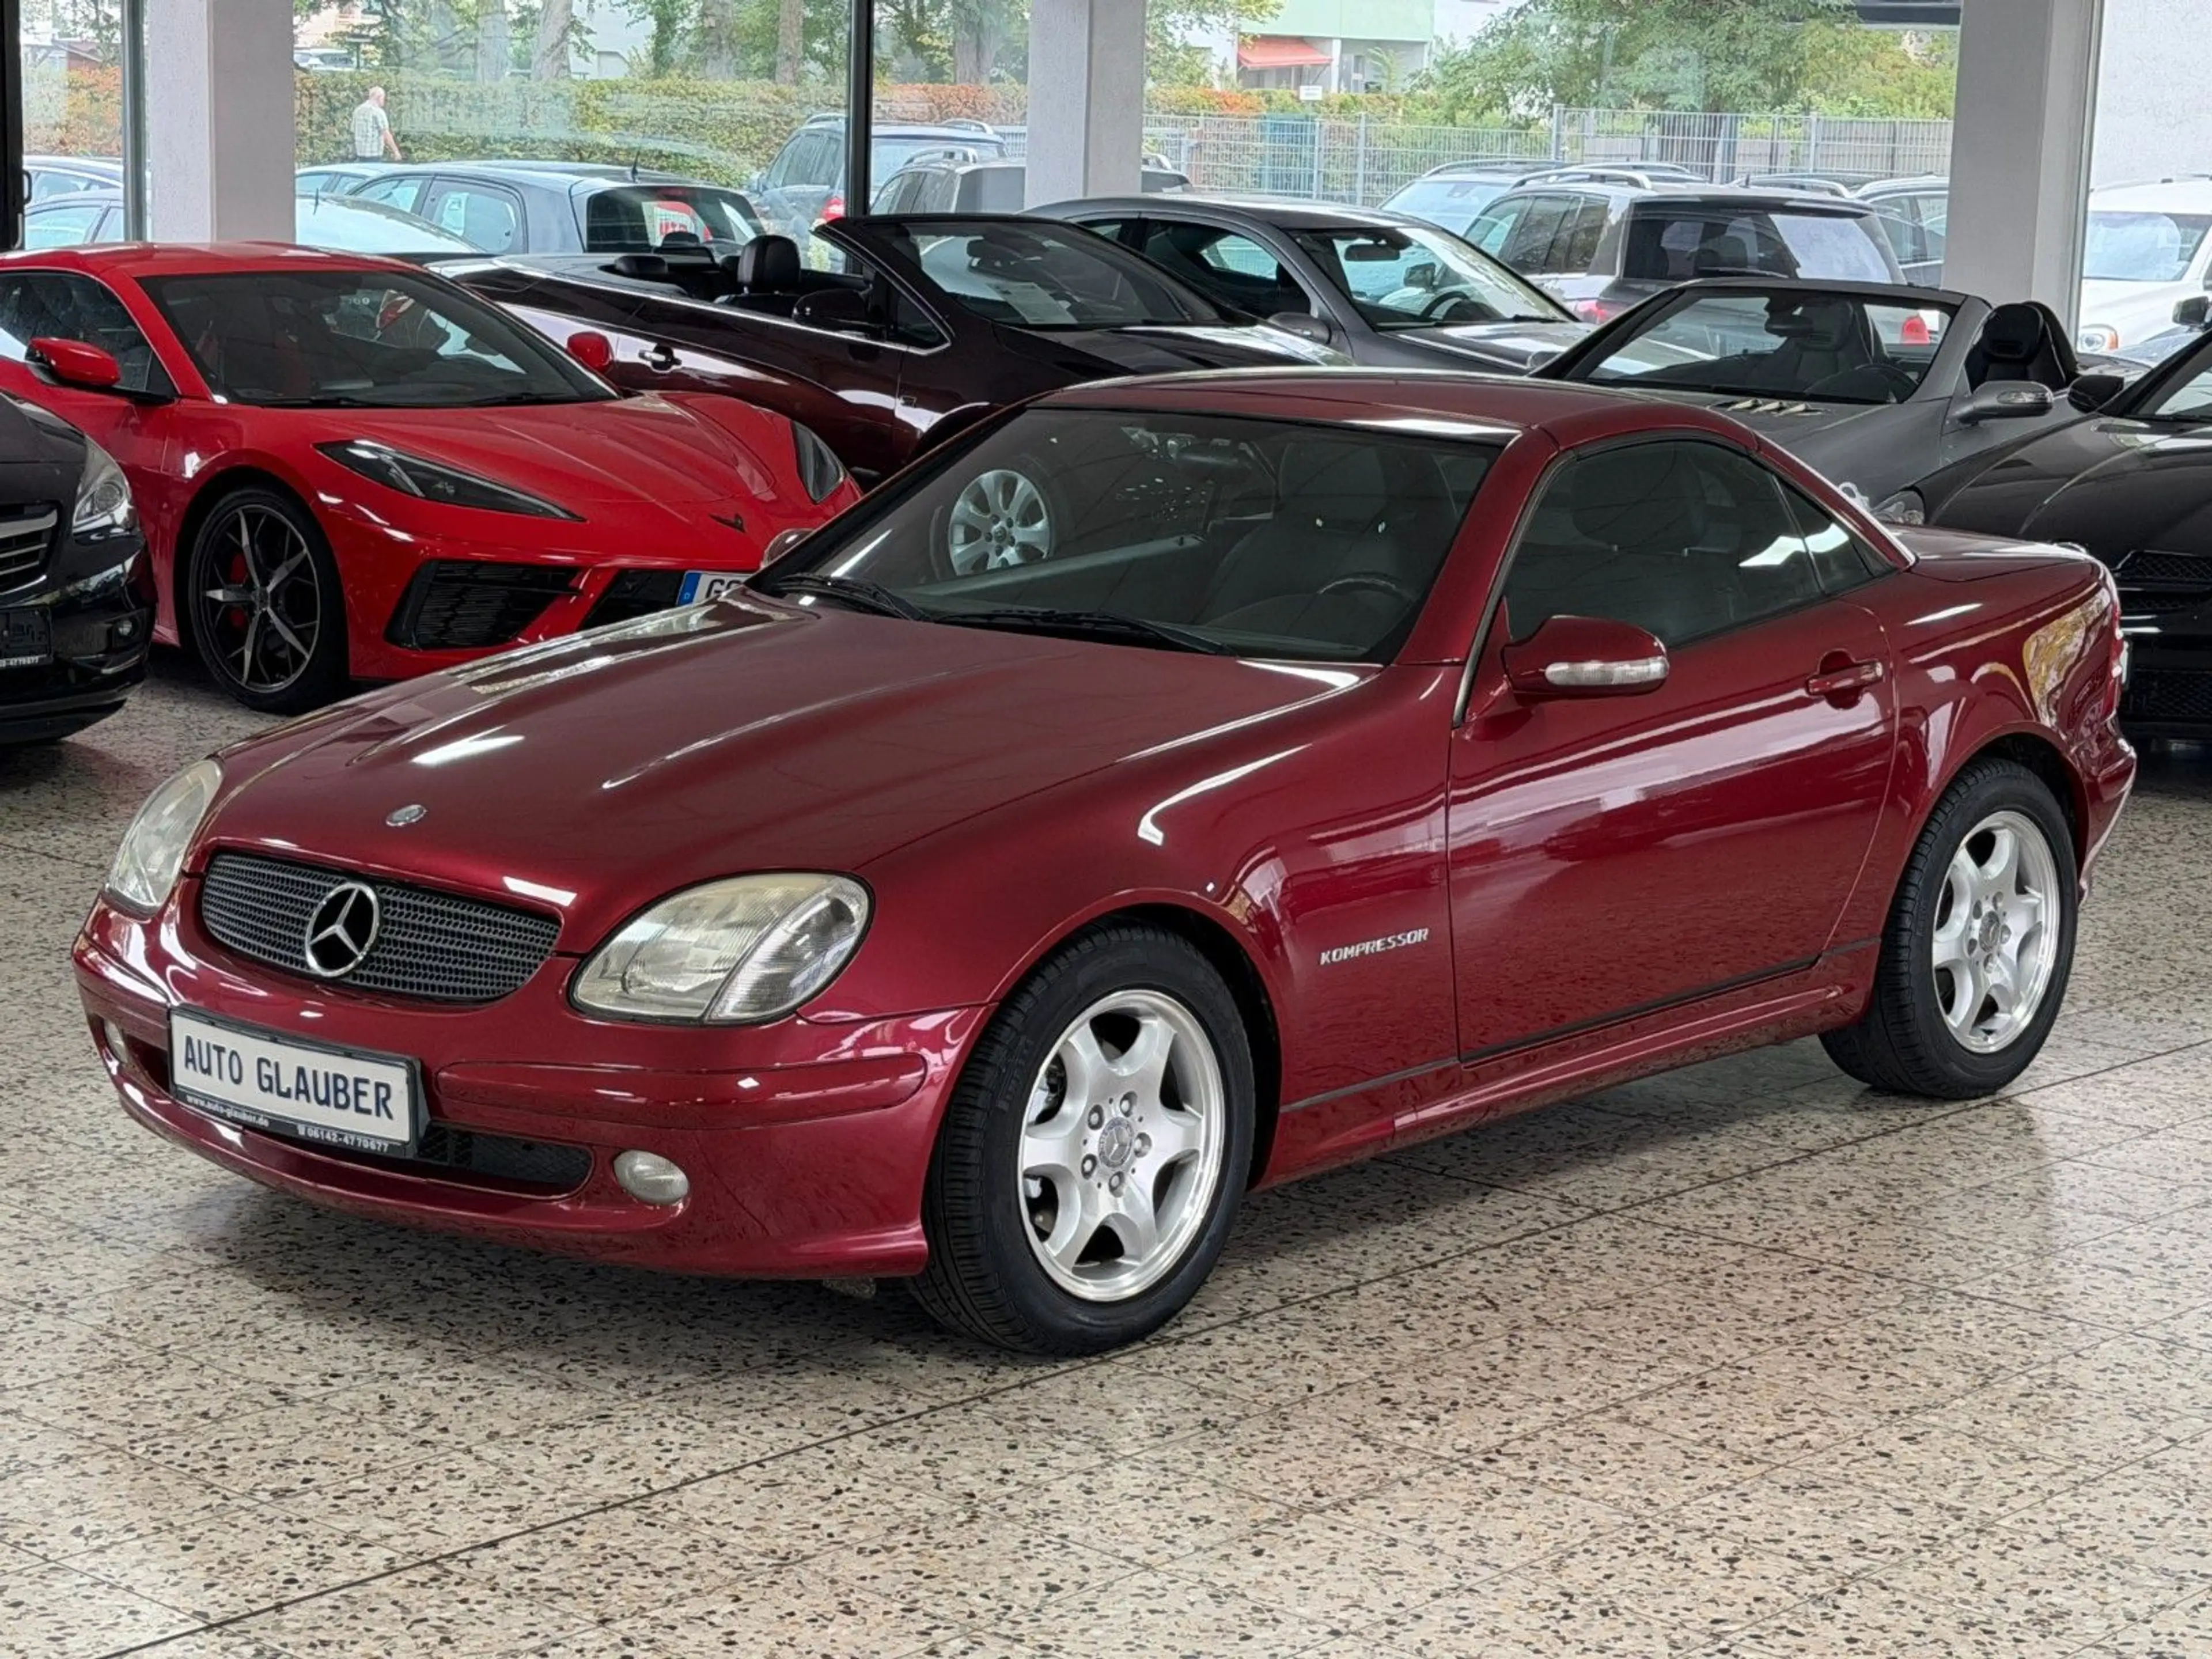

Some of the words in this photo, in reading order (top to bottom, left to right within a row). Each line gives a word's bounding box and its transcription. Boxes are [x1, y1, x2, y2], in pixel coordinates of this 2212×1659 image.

[1320, 927, 1429, 965] KOMPRESSOR
[184, 1035, 243, 1085] AUTO
[256, 1057, 394, 1120] GLAUBER
